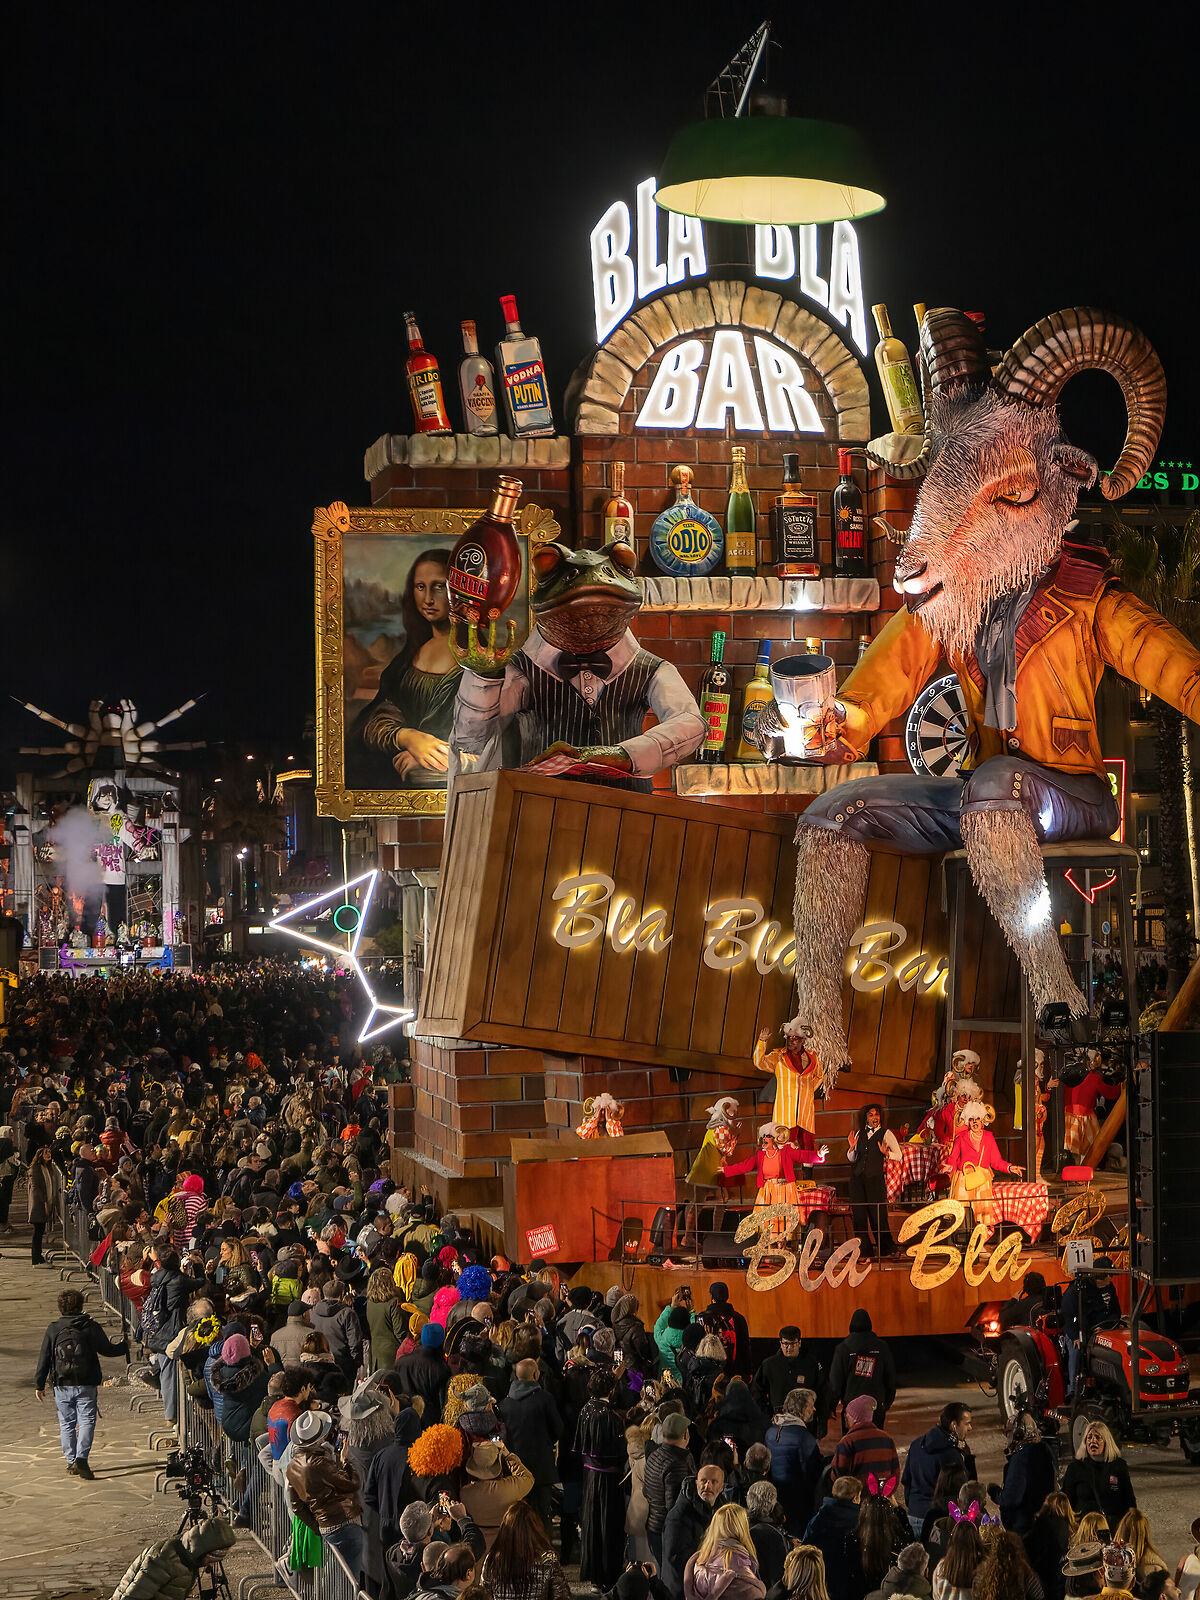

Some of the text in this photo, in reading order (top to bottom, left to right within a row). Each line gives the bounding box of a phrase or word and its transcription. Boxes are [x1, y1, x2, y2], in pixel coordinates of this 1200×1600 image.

[513, 382, 543, 405] PUTIN
[634, 330, 826, 433] BAR
[671, 529, 708, 553] ODIO
[552, 873, 674, 953] Bla
[734, 1202, 872, 1292] Bla
[898, 1199, 1032, 1290] Bla
[1075, 1249, 1087, 1263] 11
